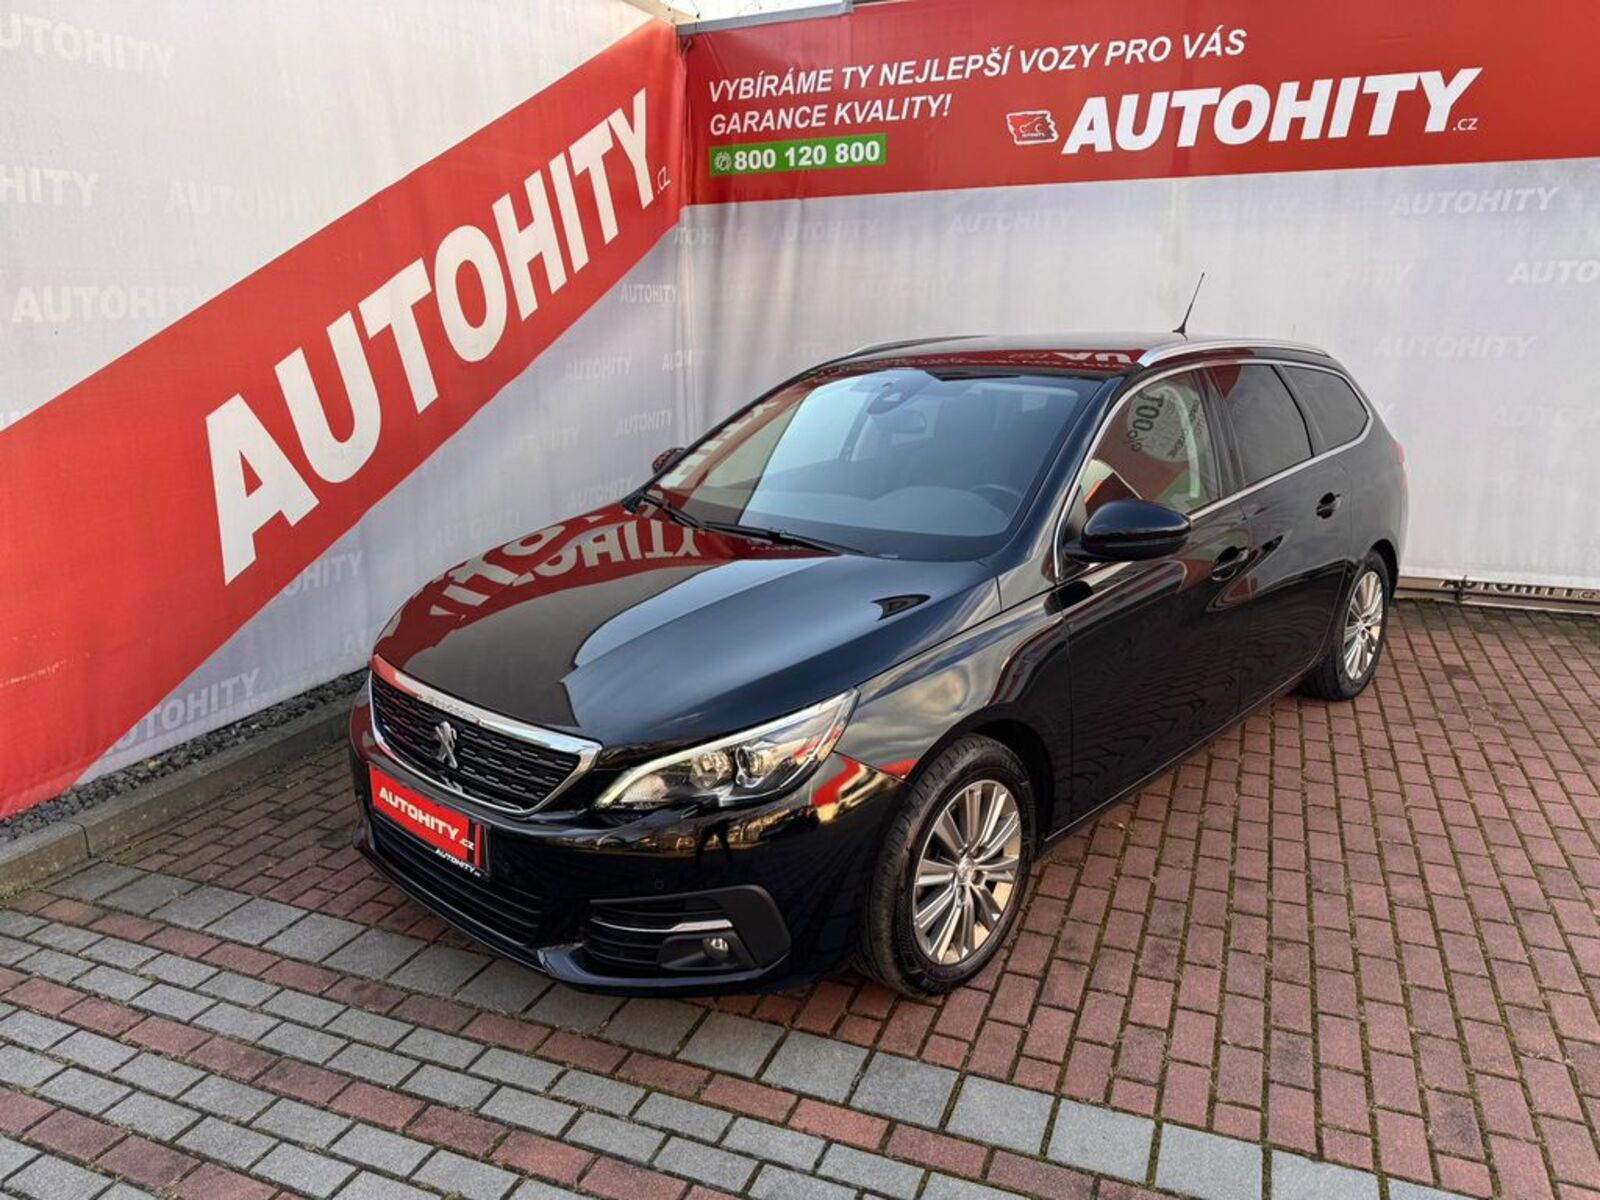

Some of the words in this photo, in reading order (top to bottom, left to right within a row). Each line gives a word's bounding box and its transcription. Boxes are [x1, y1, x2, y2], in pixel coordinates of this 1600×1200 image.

[708, 66, 834, 102] VYBÍRÁME
[841, 65, 874, 90] TY
[879, 45, 1015, 86] NEJLEPŠÍ
[1019, 43, 1099, 74] VOZY
[1104, 35, 1172, 67] PRO
[1182, 24, 1248, 59] VÁS
[709, 104, 828, 136] GARANCE
[833, 93, 953, 126] KVALITY!
[733, 149, 777, 171] 800
[785, 145, 827, 167] 120
[834, 140, 881, 163] 800
[1392, 186, 1560, 218] AUTOHITY
